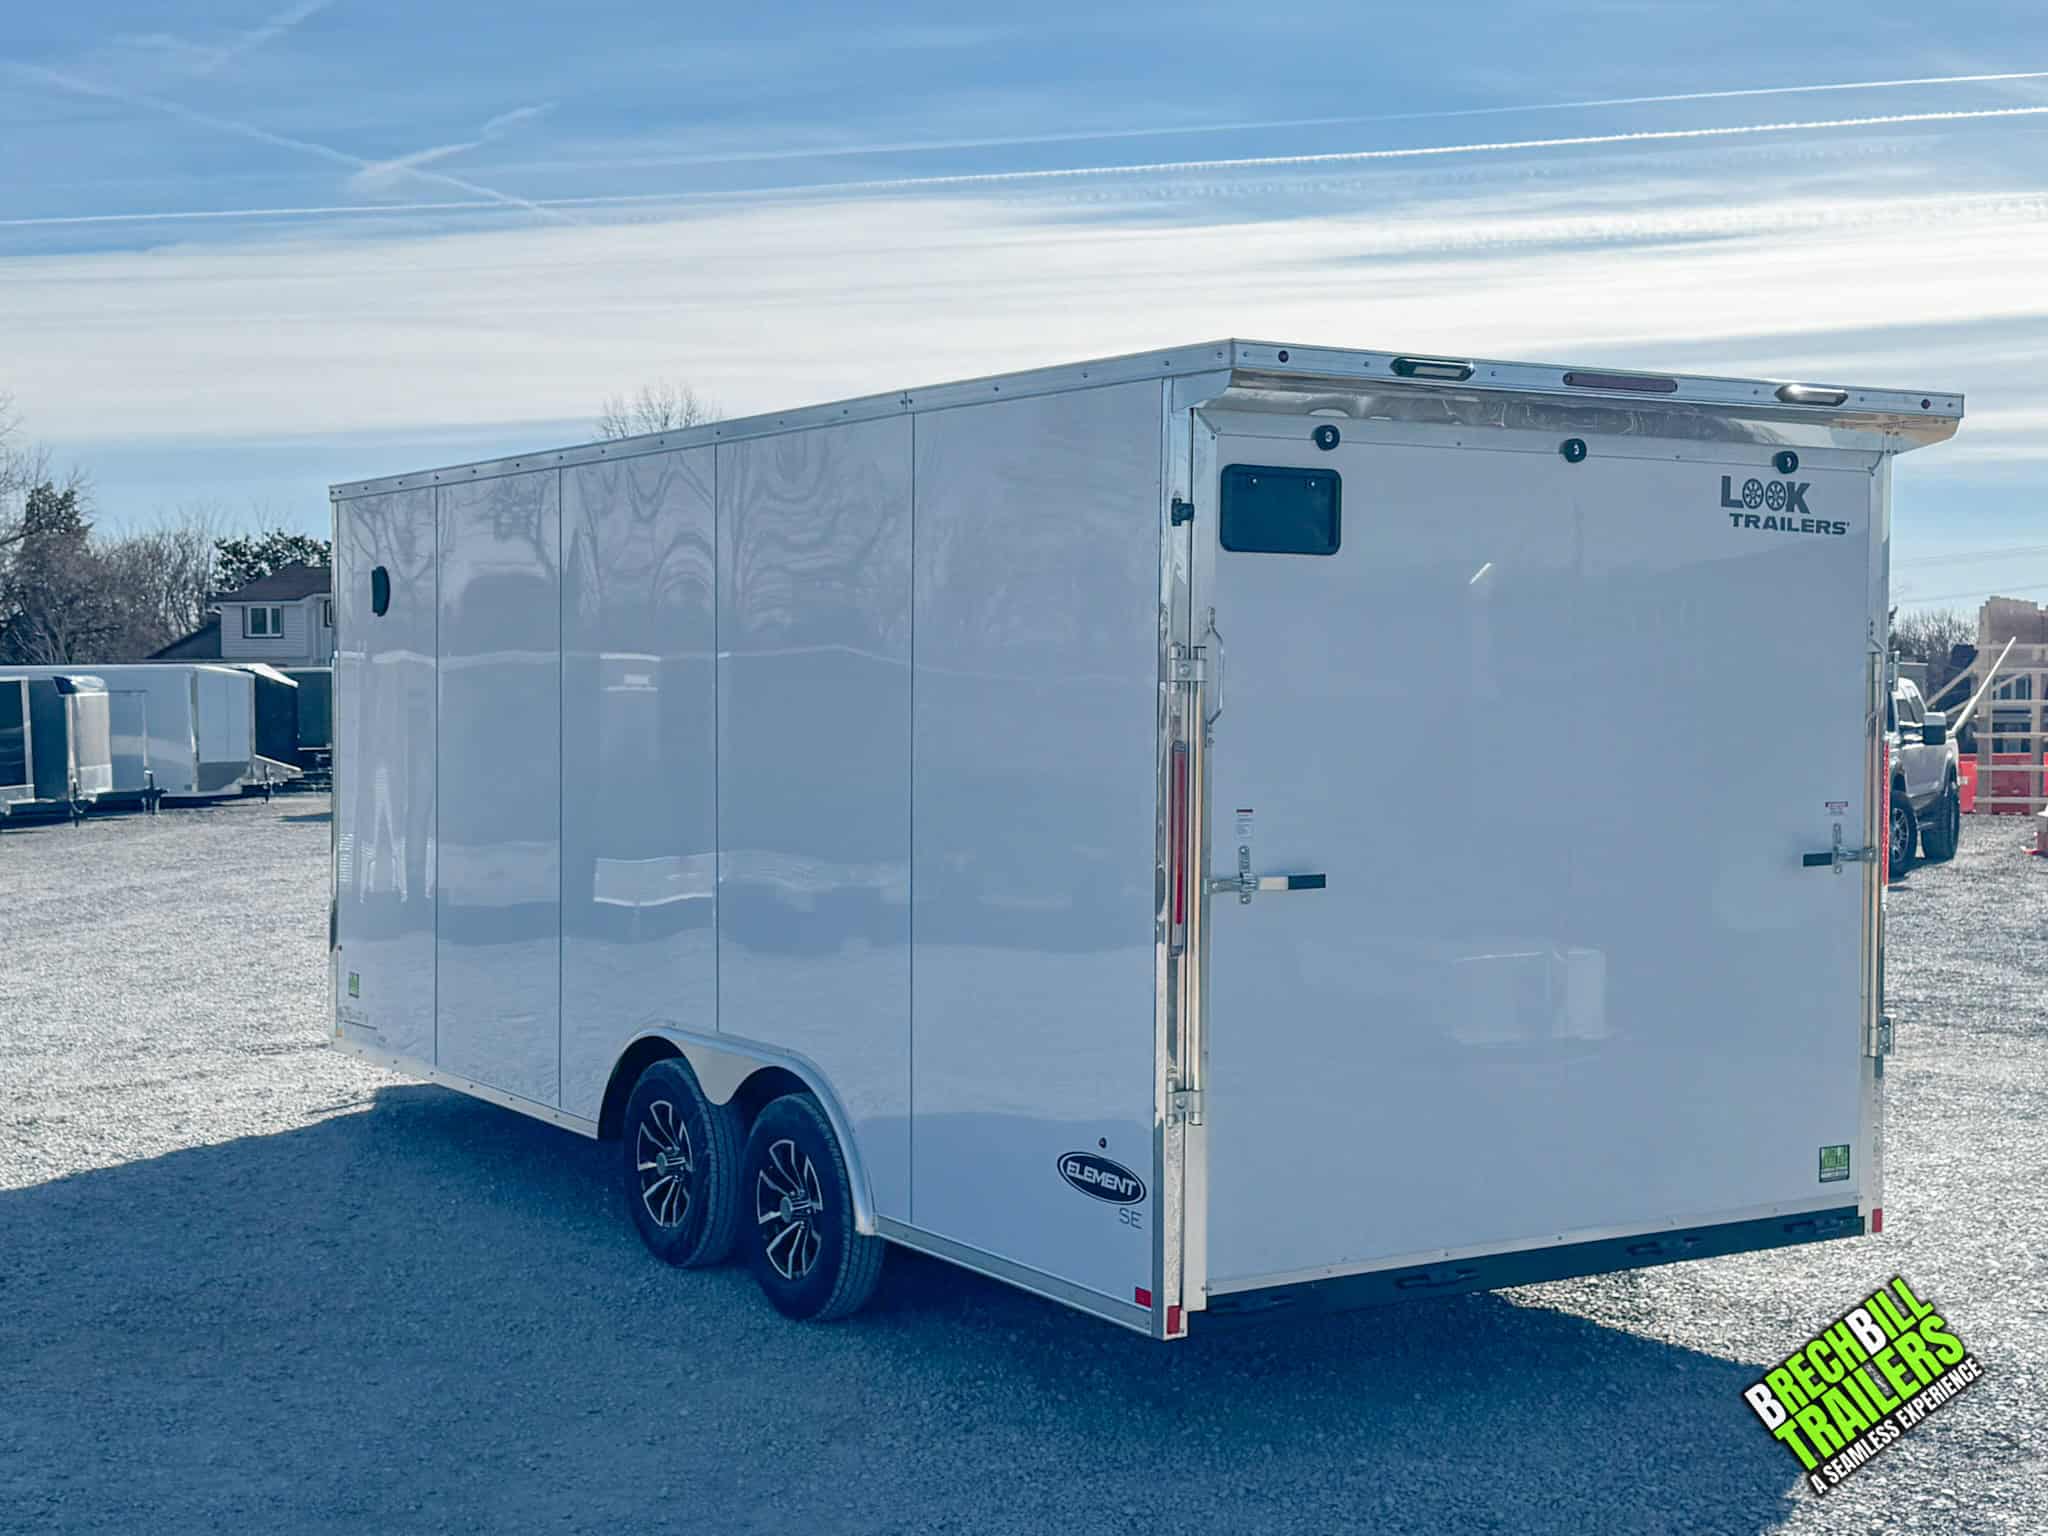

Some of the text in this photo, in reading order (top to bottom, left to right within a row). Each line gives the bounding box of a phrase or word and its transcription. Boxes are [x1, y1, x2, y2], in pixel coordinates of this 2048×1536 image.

[1720, 475, 1811, 515] LOOK
[1729, 512, 1847, 536] TRAILERS
[1066, 1160, 1137, 1197] ELEMENT
[1119, 1207, 1143, 1231] SE
